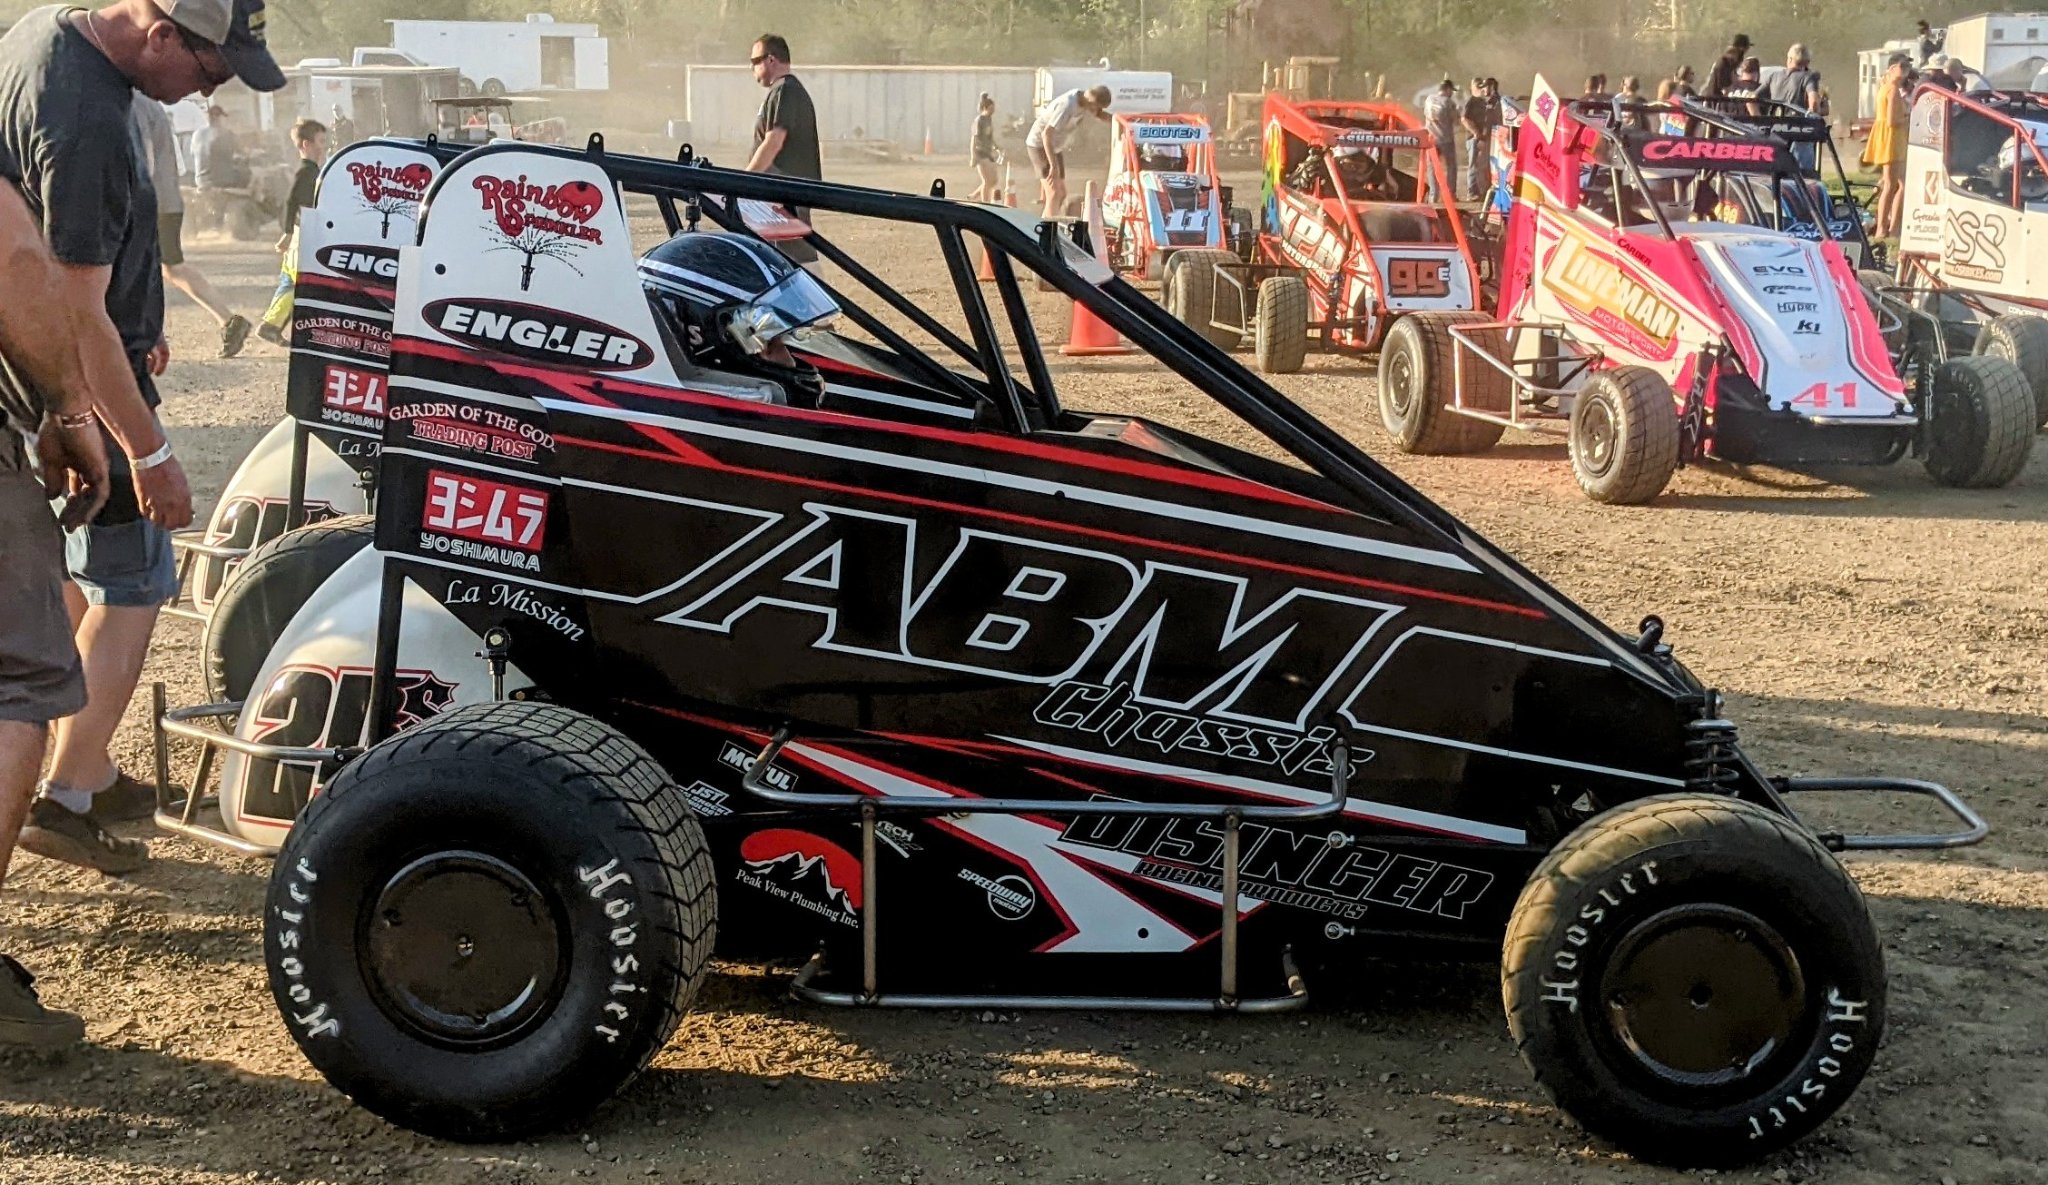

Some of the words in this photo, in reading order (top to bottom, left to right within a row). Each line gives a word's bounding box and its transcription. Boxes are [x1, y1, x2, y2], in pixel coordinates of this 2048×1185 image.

[1642, 140, 1775, 162] CARBER
[346, 160, 433, 195] Rainbow
[472, 174, 603, 226] Rainbow
[328, 250, 398, 278] ENG
[1543, 231, 1679, 342] LINEMAN
[295, 317, 341, 330] GARDEN
[342, 319, 358, 329] OF
[359, 321, 382, 337] THE
[439, 305, 640, 366] ENGLER
[327, 369, 384, 414] ヨシム
[1791, 382, 1857, 408] 41
[321, 407, 384, 430] YOSHIMU
[389, 403, 457, 420] GARDEN
[460, 405, 482, 421] OF
[484, 410, 517, 432] THE
[412, 419, 487, 450] TRADING
[491, 435, 536, 459] POST
[338, 438, 361, 456] La
[420, 531, 541, 572] YOSHIMURA
[443, 579, 480, 605] La
[489, 582, 586, 642] Mission
[653, 501, 1407, 732] ABM
[722, 747, 791, 790] MOUL
[690, 786, 724, 801] JST
[1058, 794, 1494, 919] DISINGER
[735, 869, 762, 888] Peak
[764, 880, 790, 899] View
[789, 891, 840, 922] Plumbing
[839, 911, 859, 928] Inc.
[957, 868, 1032, 908] SPEEDWAY
[274, 857, 341, 1040] Hoosier
[578, 858, 648, 1044] Hoosier
[1540, 859, 1659, 1014] Hoosier
[1748, 986, 1868, 1140] Hoosier
